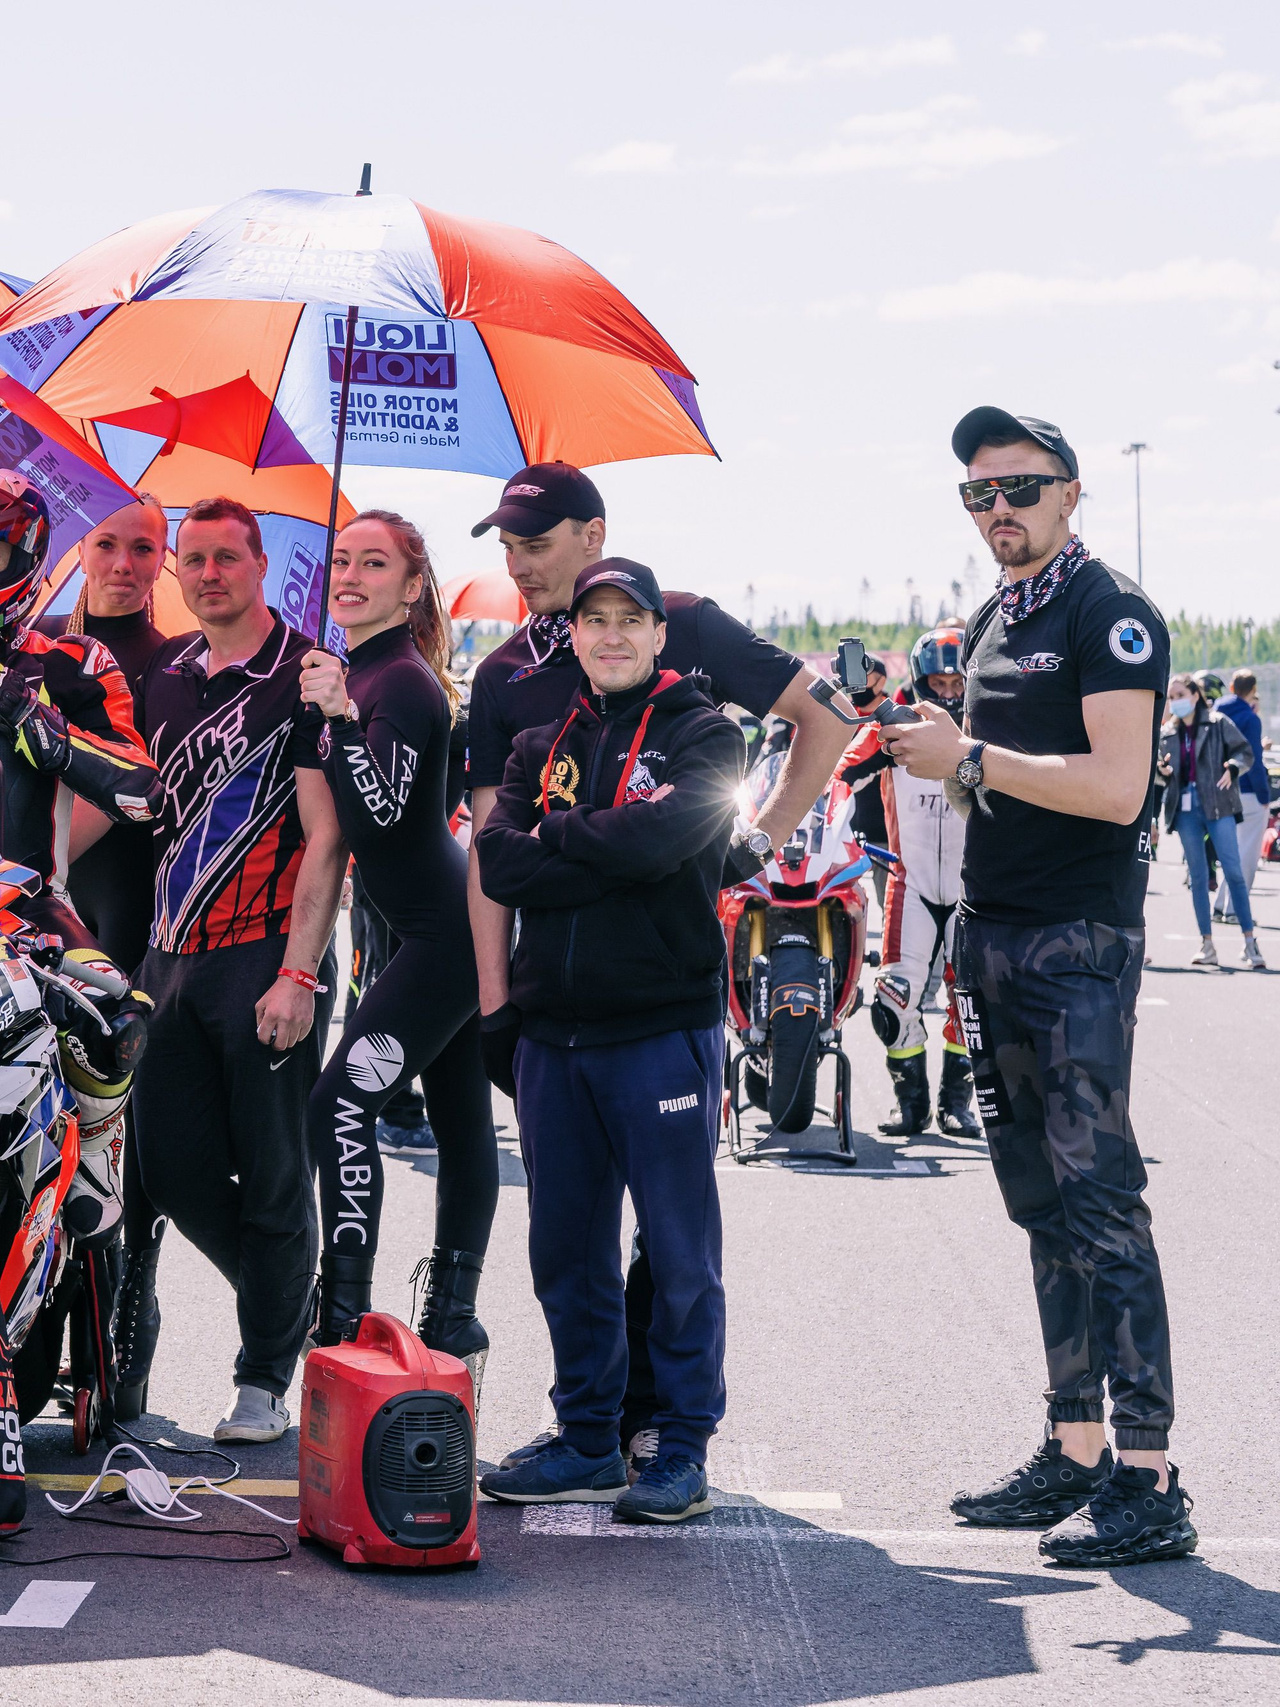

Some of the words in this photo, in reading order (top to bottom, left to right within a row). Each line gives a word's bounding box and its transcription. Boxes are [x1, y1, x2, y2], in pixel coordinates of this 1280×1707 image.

[1115, 620, 1148, 637] BMW
[1017, 652, 1064, 672] RLS
[343, 745, 395, 827] CREW
[658, 1093, 699, 1114] PUMA
[333, 1097, 373, 1245] МАВИС
